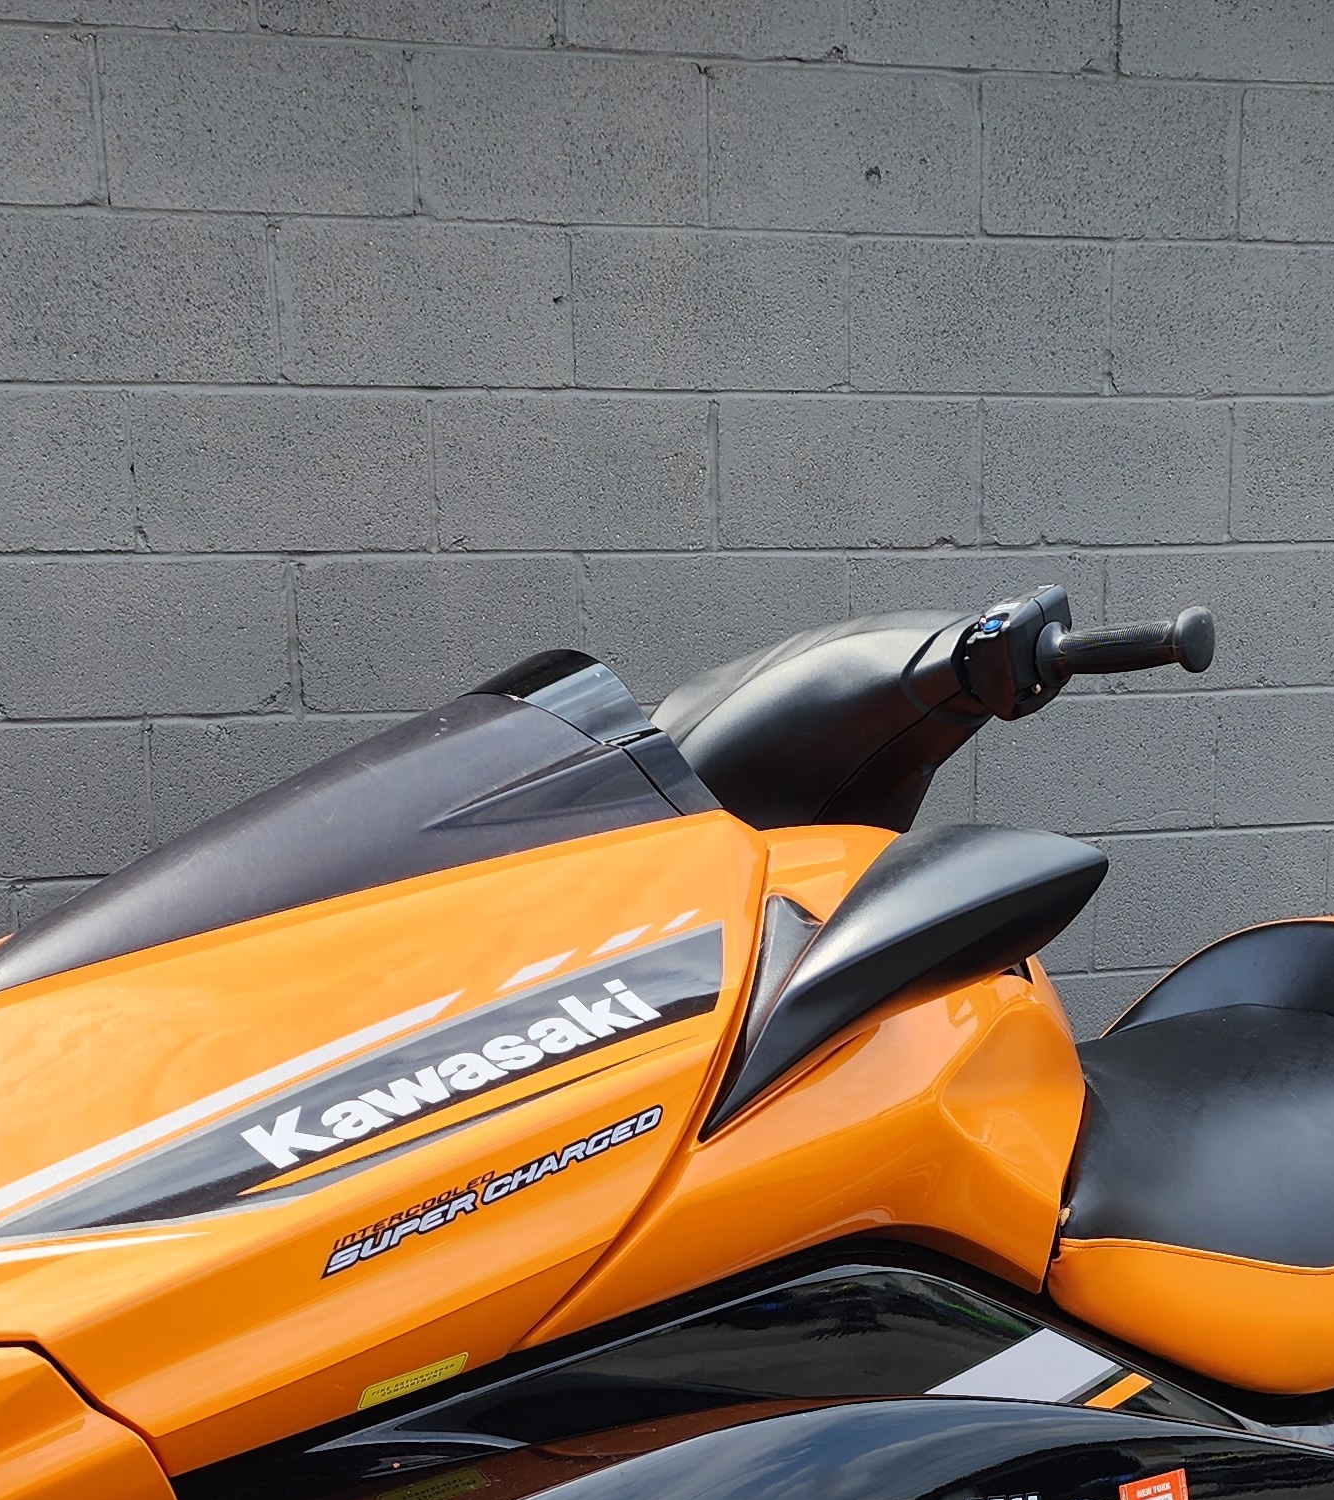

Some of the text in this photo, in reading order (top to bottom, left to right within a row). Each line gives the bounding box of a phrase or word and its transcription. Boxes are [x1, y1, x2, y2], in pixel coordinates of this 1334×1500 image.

[241, 978, 662, 1170] Kawasaki
[324, 1105, 663, 1278] SUPER CHARGED
[333, 1170, 495, 1252] INTERCOOLED
